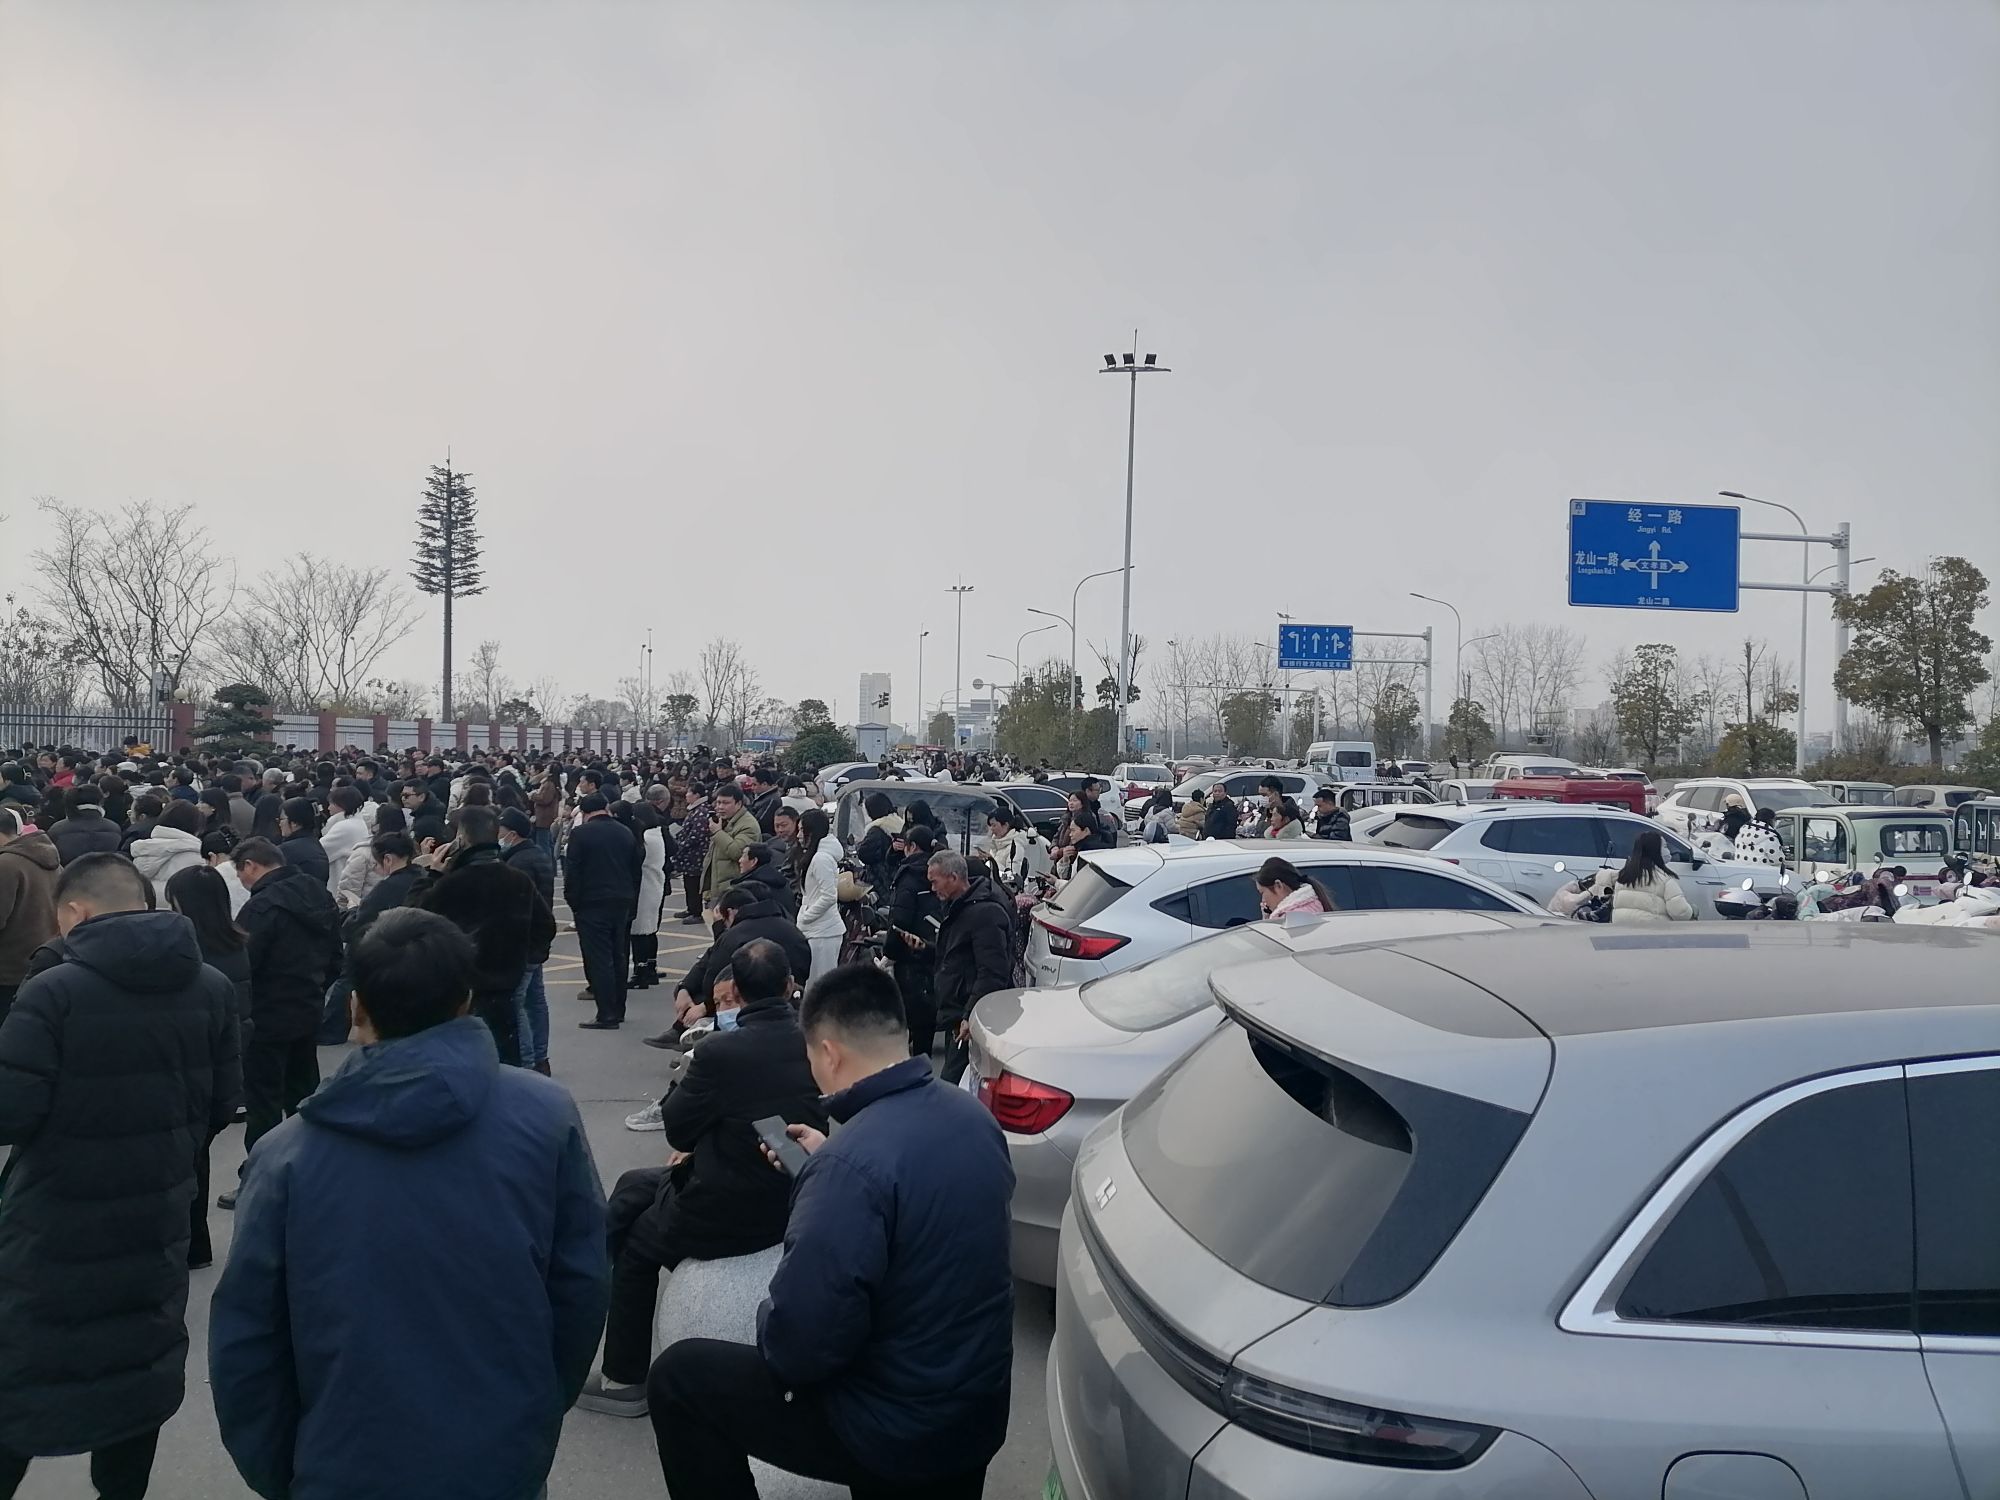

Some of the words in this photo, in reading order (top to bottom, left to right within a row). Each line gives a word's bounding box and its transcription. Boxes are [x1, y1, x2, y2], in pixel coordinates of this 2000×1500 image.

[1628, 508, 1682, 525] 经一路
[1637, 525, 1656, 534] Jingyi
[1661, 526, 1673, 534] Rd.
[1575, 550, 1619, 567] 龙山一路
[1637, 596, 1670, 606] 龙山二路
